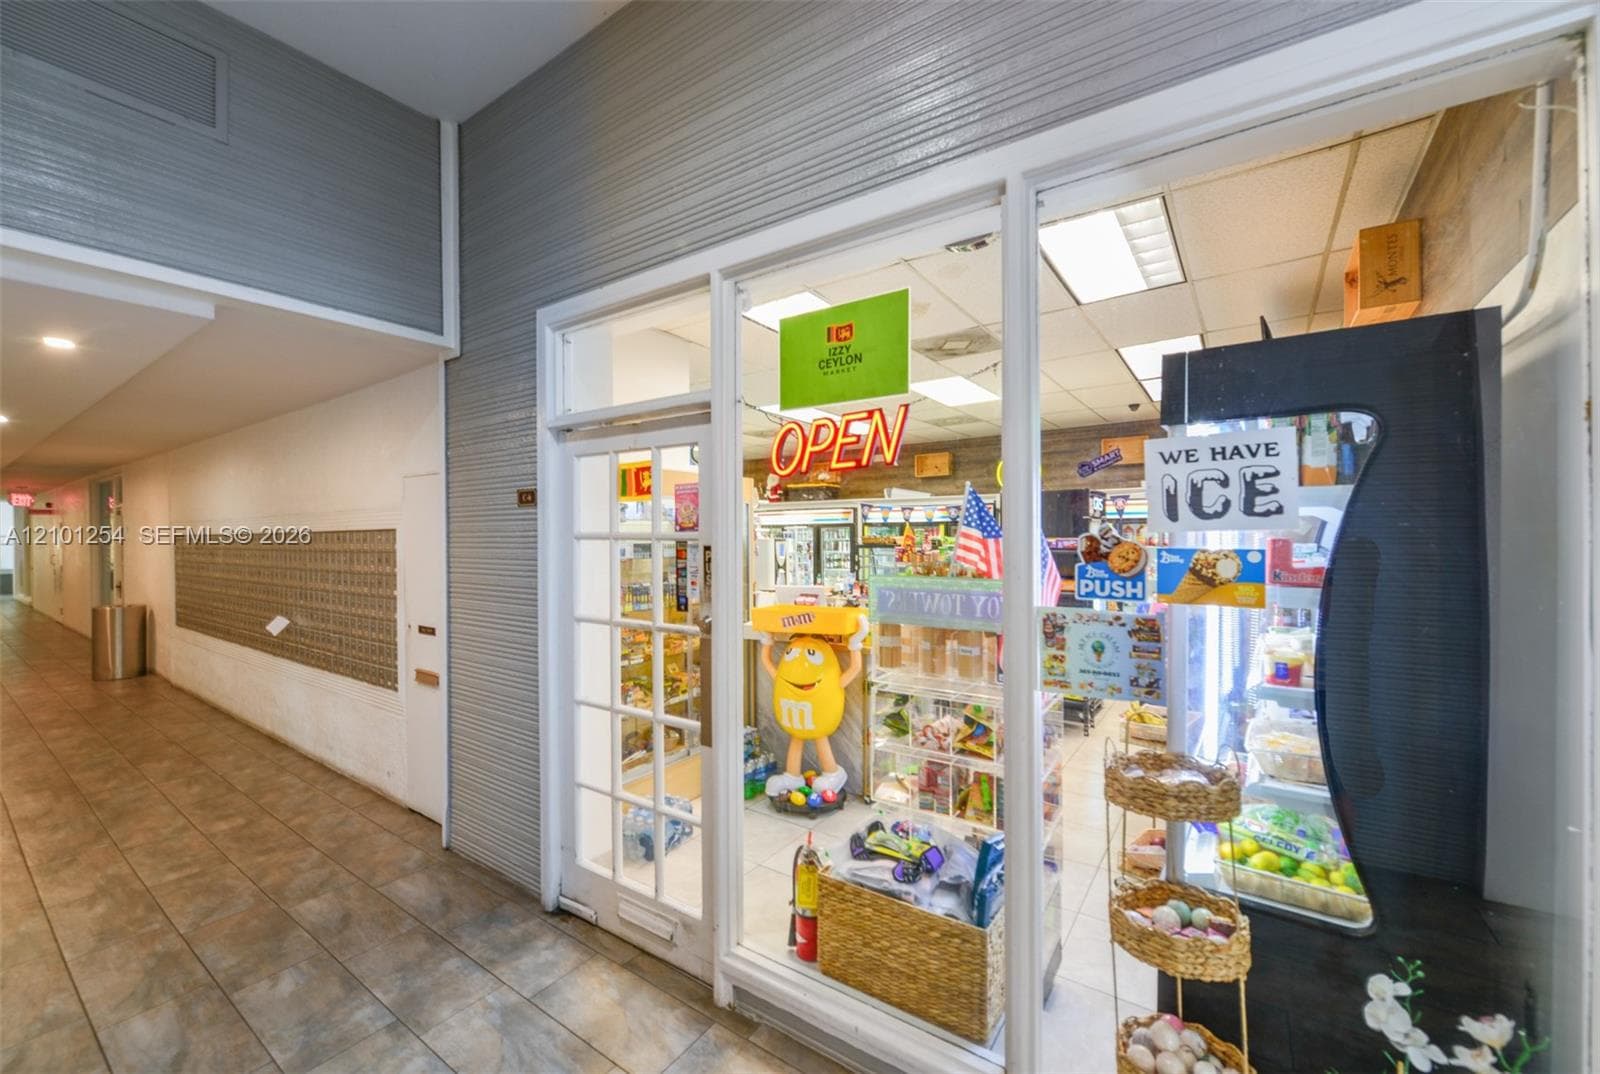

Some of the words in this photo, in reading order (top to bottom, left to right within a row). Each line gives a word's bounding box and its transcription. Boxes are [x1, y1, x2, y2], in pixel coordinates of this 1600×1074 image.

[828, 344, 852, 358] IZZY
[818, 353, 863, 371] CEYLON
[823, 366, 857, 376] MARKET
[771, 403, 910, 477] OPEN
[1159, 448, 1199, 465] WE
[1210, 442, 1280, 461] HAVE
[1161, 465, 1284, 523] ICE
[1079, 579, 1144, 598] PUSH
[779, 698, 816, 731] m
